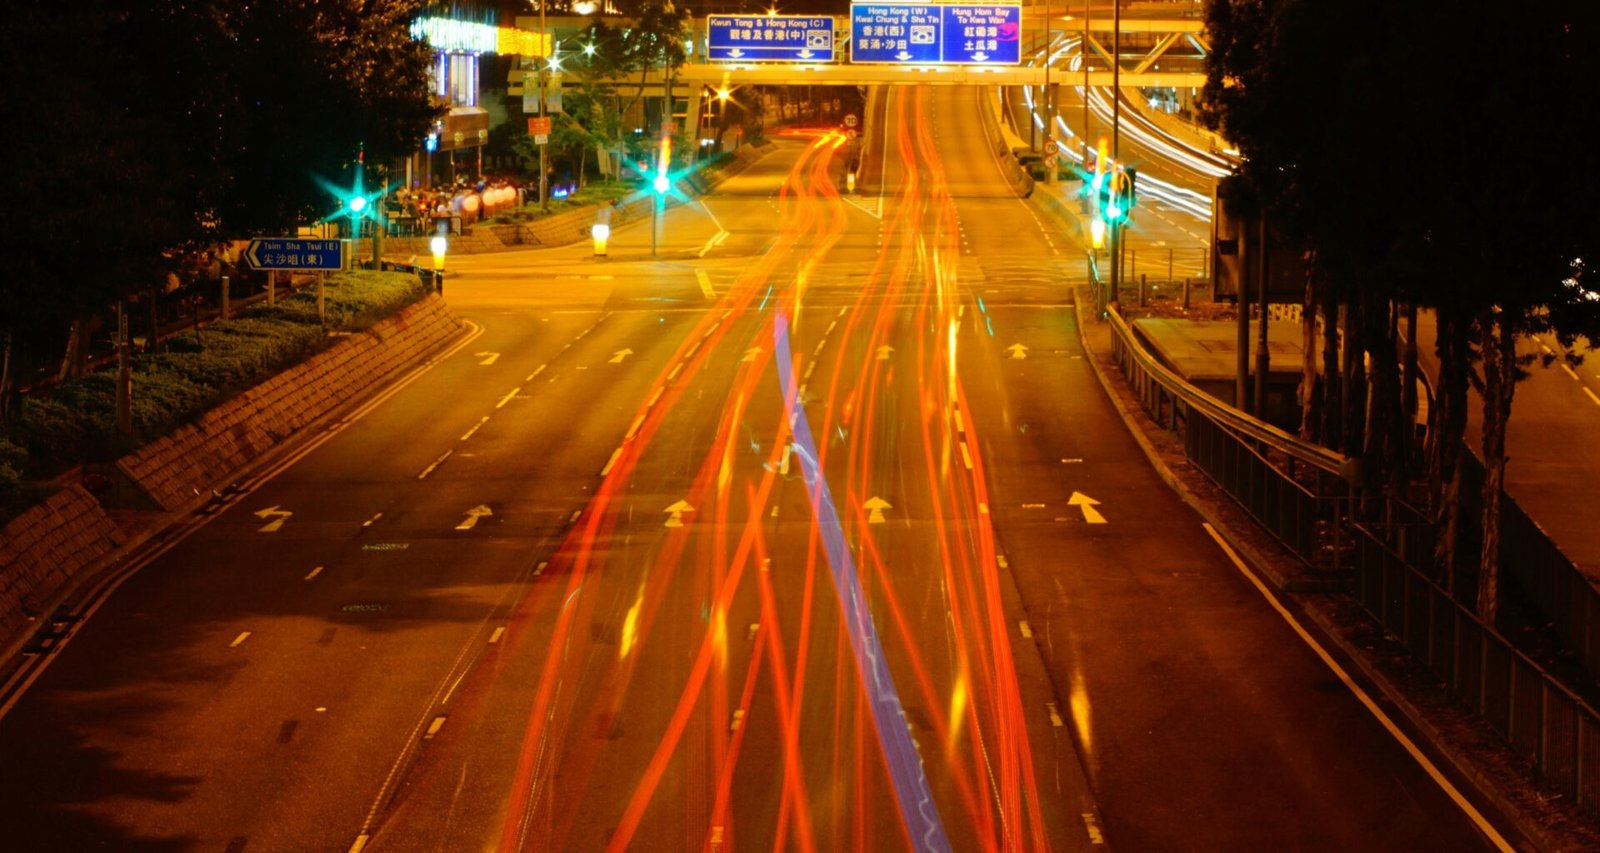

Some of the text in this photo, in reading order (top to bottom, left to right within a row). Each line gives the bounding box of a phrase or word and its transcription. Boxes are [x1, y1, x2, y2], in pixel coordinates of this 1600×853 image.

[868, 7, 928, 16] Hong Kong (W)
[952, 8, 1010, 17] Hung Hom Bay
[710, 18, 825, 28] Kwun Tong & Hong Kong (C)
[855, 15, 940, 24] Kwai Chung & Sha Tin
[957, 16, 1006, 24] To Kwa Wan
[730, 29, 805, 40] 觀塘及香港(中)
[863, 25, 905, 37] 香港(西)
[964, 39, 998, 51] 土瓜灣
[264, 242, 339, 251] Tsim Sha Tsui (E)
